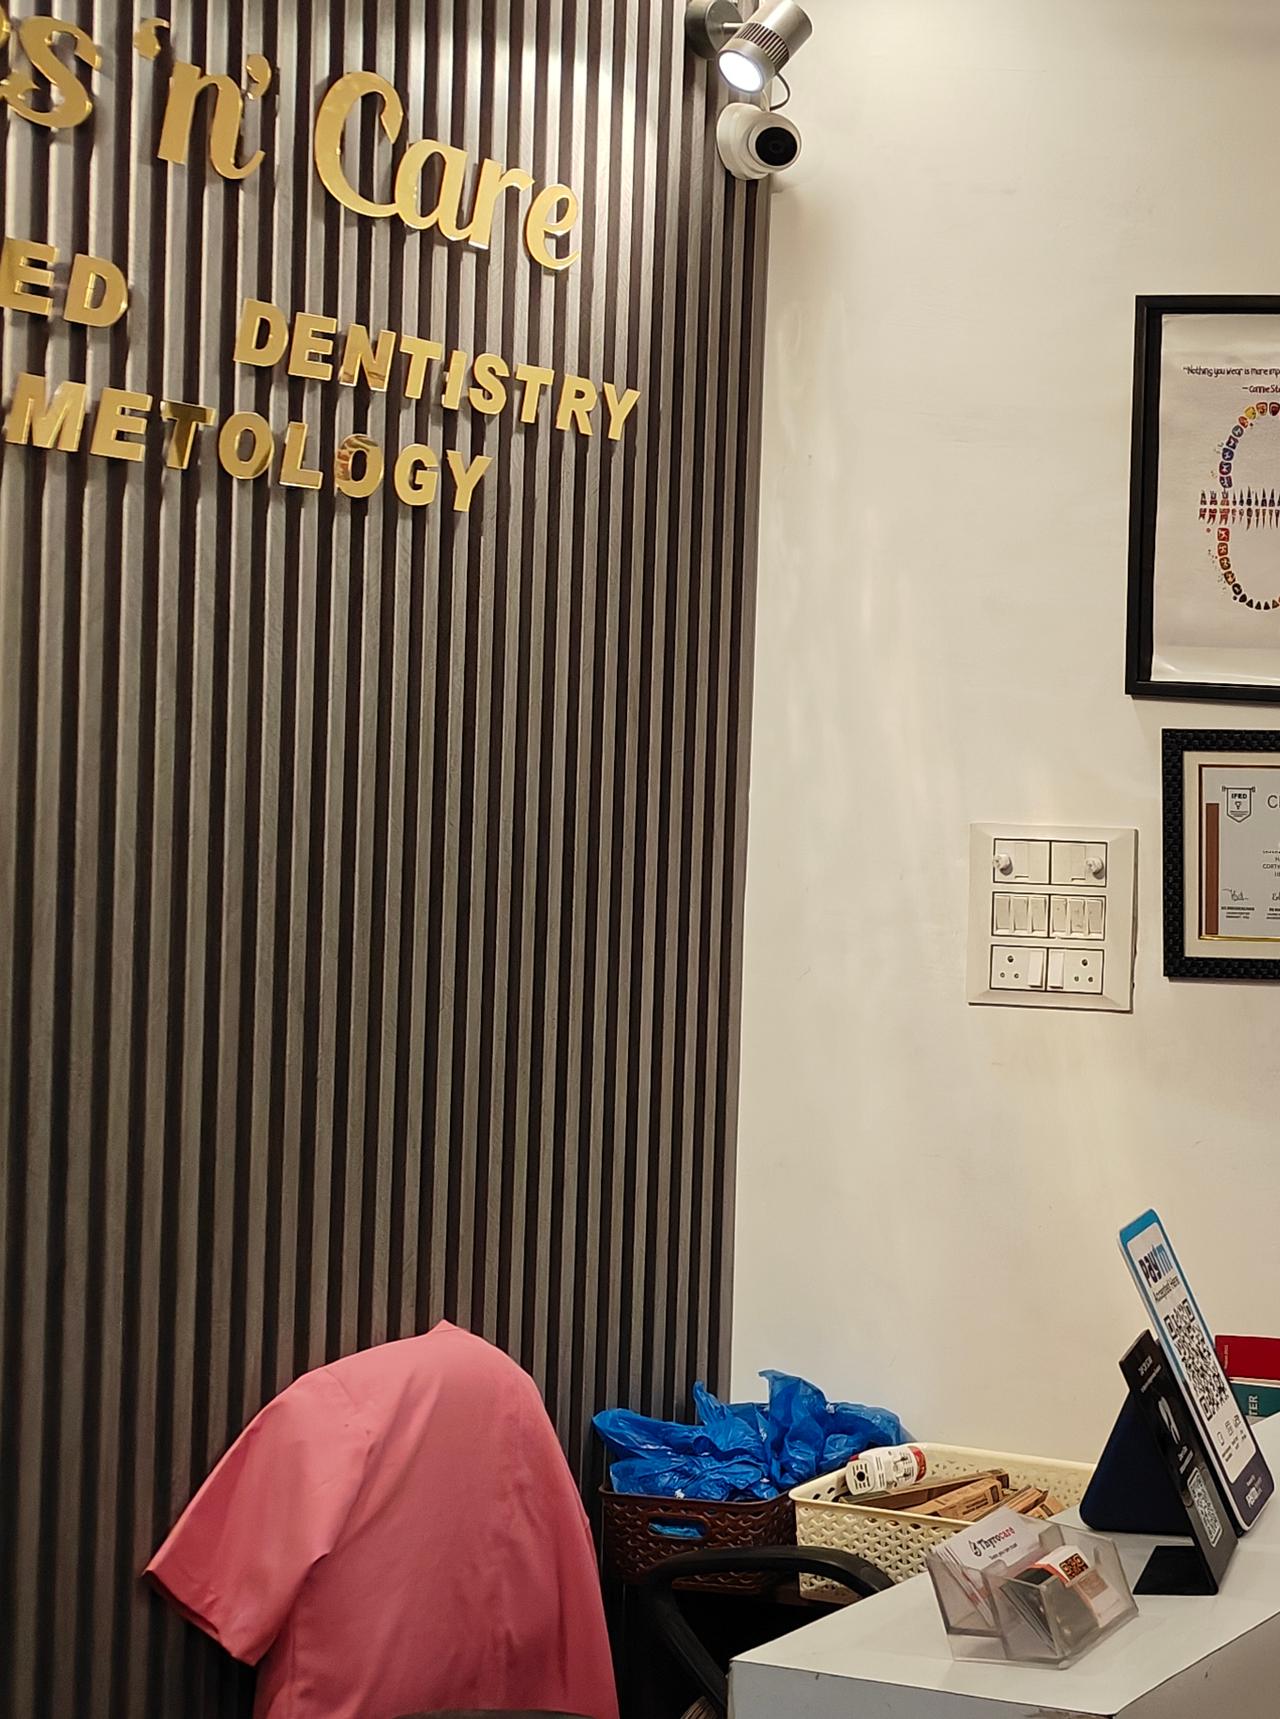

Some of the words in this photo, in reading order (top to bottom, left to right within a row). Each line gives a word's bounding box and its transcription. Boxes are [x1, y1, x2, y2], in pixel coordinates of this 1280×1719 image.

[314, 70, 582, 271] Care
[233, 298, 641, 441] DENTISTRY
[4, 373, 493, 512] METOLOGY
[977, 1526, 1015, 1550] Thyrocare
